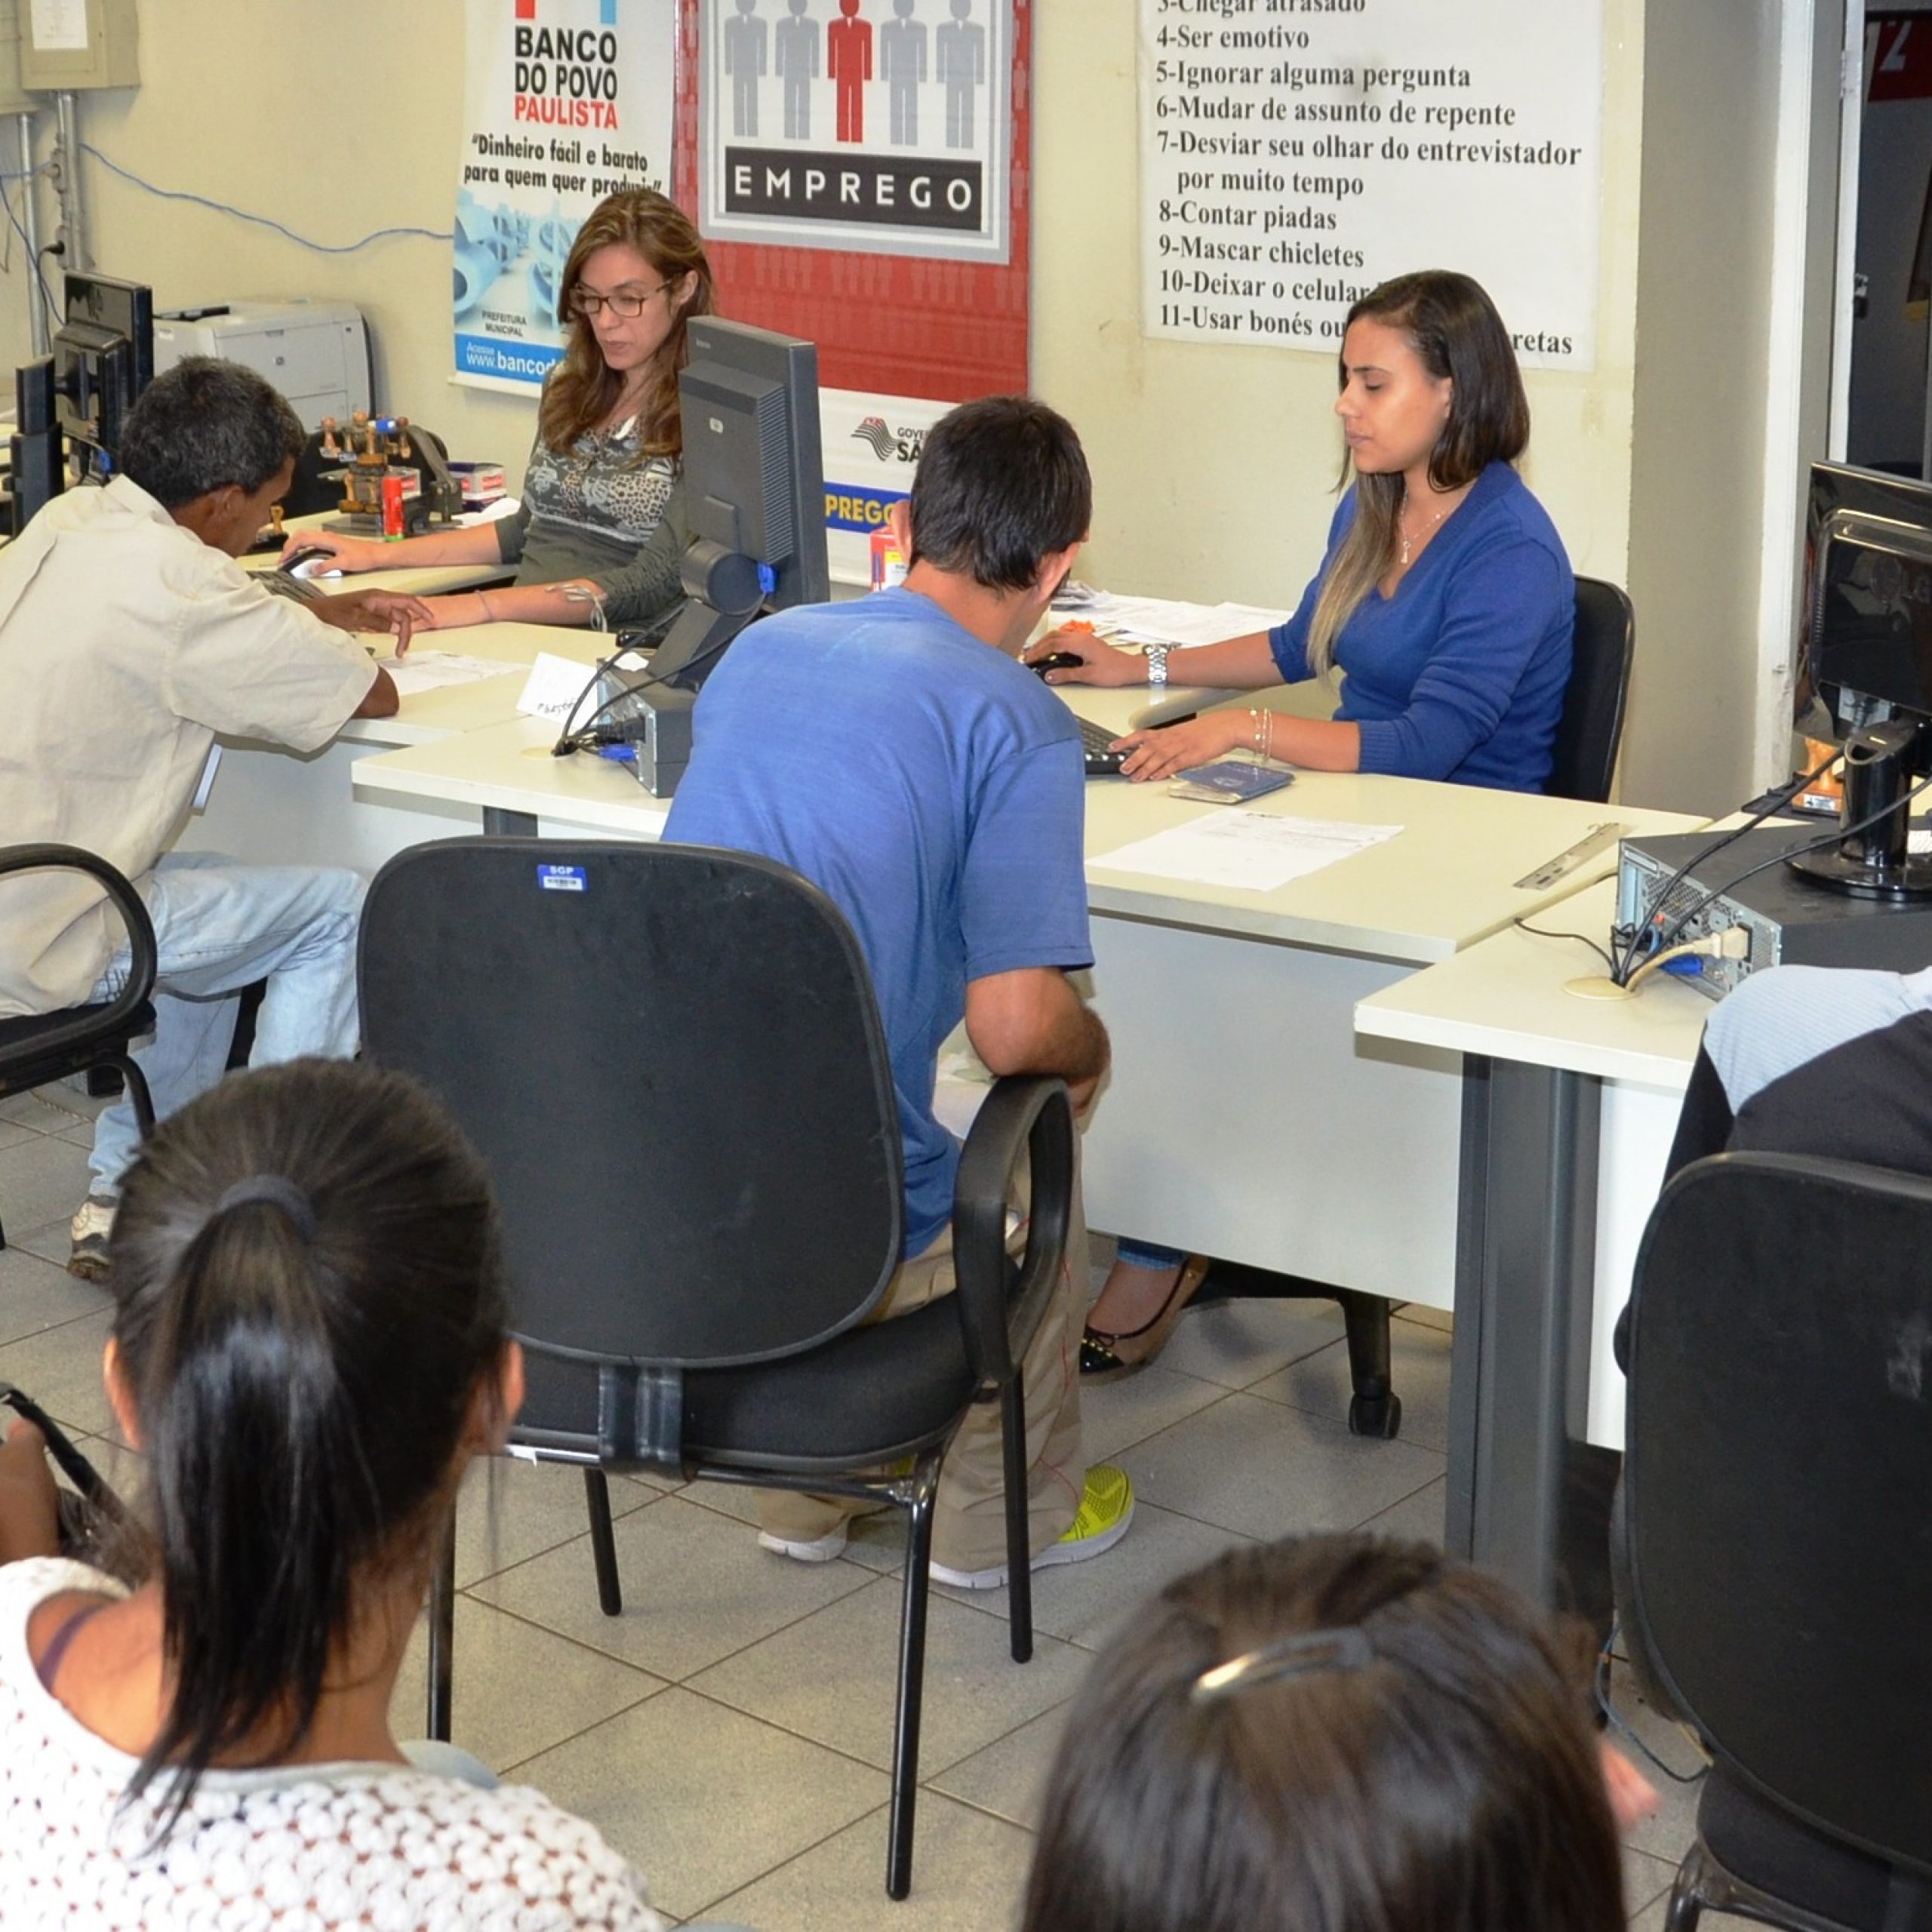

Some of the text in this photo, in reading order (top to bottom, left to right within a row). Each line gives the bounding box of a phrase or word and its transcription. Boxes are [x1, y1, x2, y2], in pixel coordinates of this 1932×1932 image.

[1266, 0, 1365, 13] atrasado
[515, 26, 617, 63] BANCO
[1157, 25, 1309, 48] 4-Ser emotivo
[515, 61, 617, 100] DO POVO
[1157, 60, 1471, 93] 5-Ignorar alguma pergunta
[515, 97, 617, 129] PAULISTA
[1157, 96, 1516, 131] 6-Mudar de assunto de repente
[549, 138, 581, 164] fácil
[586, 149, 597, 165] e
[602, 143, 648, 171] barato
[1158, 131, 1582, 165] 7-Desviar seu olhar do entrevistador
[464, 165, 499, 184] para
[505, 168, 546, 189] quem
[552, 174, 586, 193] quer
[734, 165, 972, 212] EMPREGO
[1177, 168, 1364, 201] por muito tempo
[1159, 200, 1337, 233] 8-Contar piadas
[1159, 235, 1364, 268] 9-Mascar chicletes
[1161, 269, 1370, 302] 10-Deixar o celular
[481, 310, 527, 325] PREFEITURA
[485, 323, 522, 337] MUNICIPAL
[1161, 305, 1572, 354] 11-Usar bonés ou retas
[897, 427, 925, 439] GOVE
[897, 439, 921, 463] SÃ
[825, 494, 895, 525] PREGO
